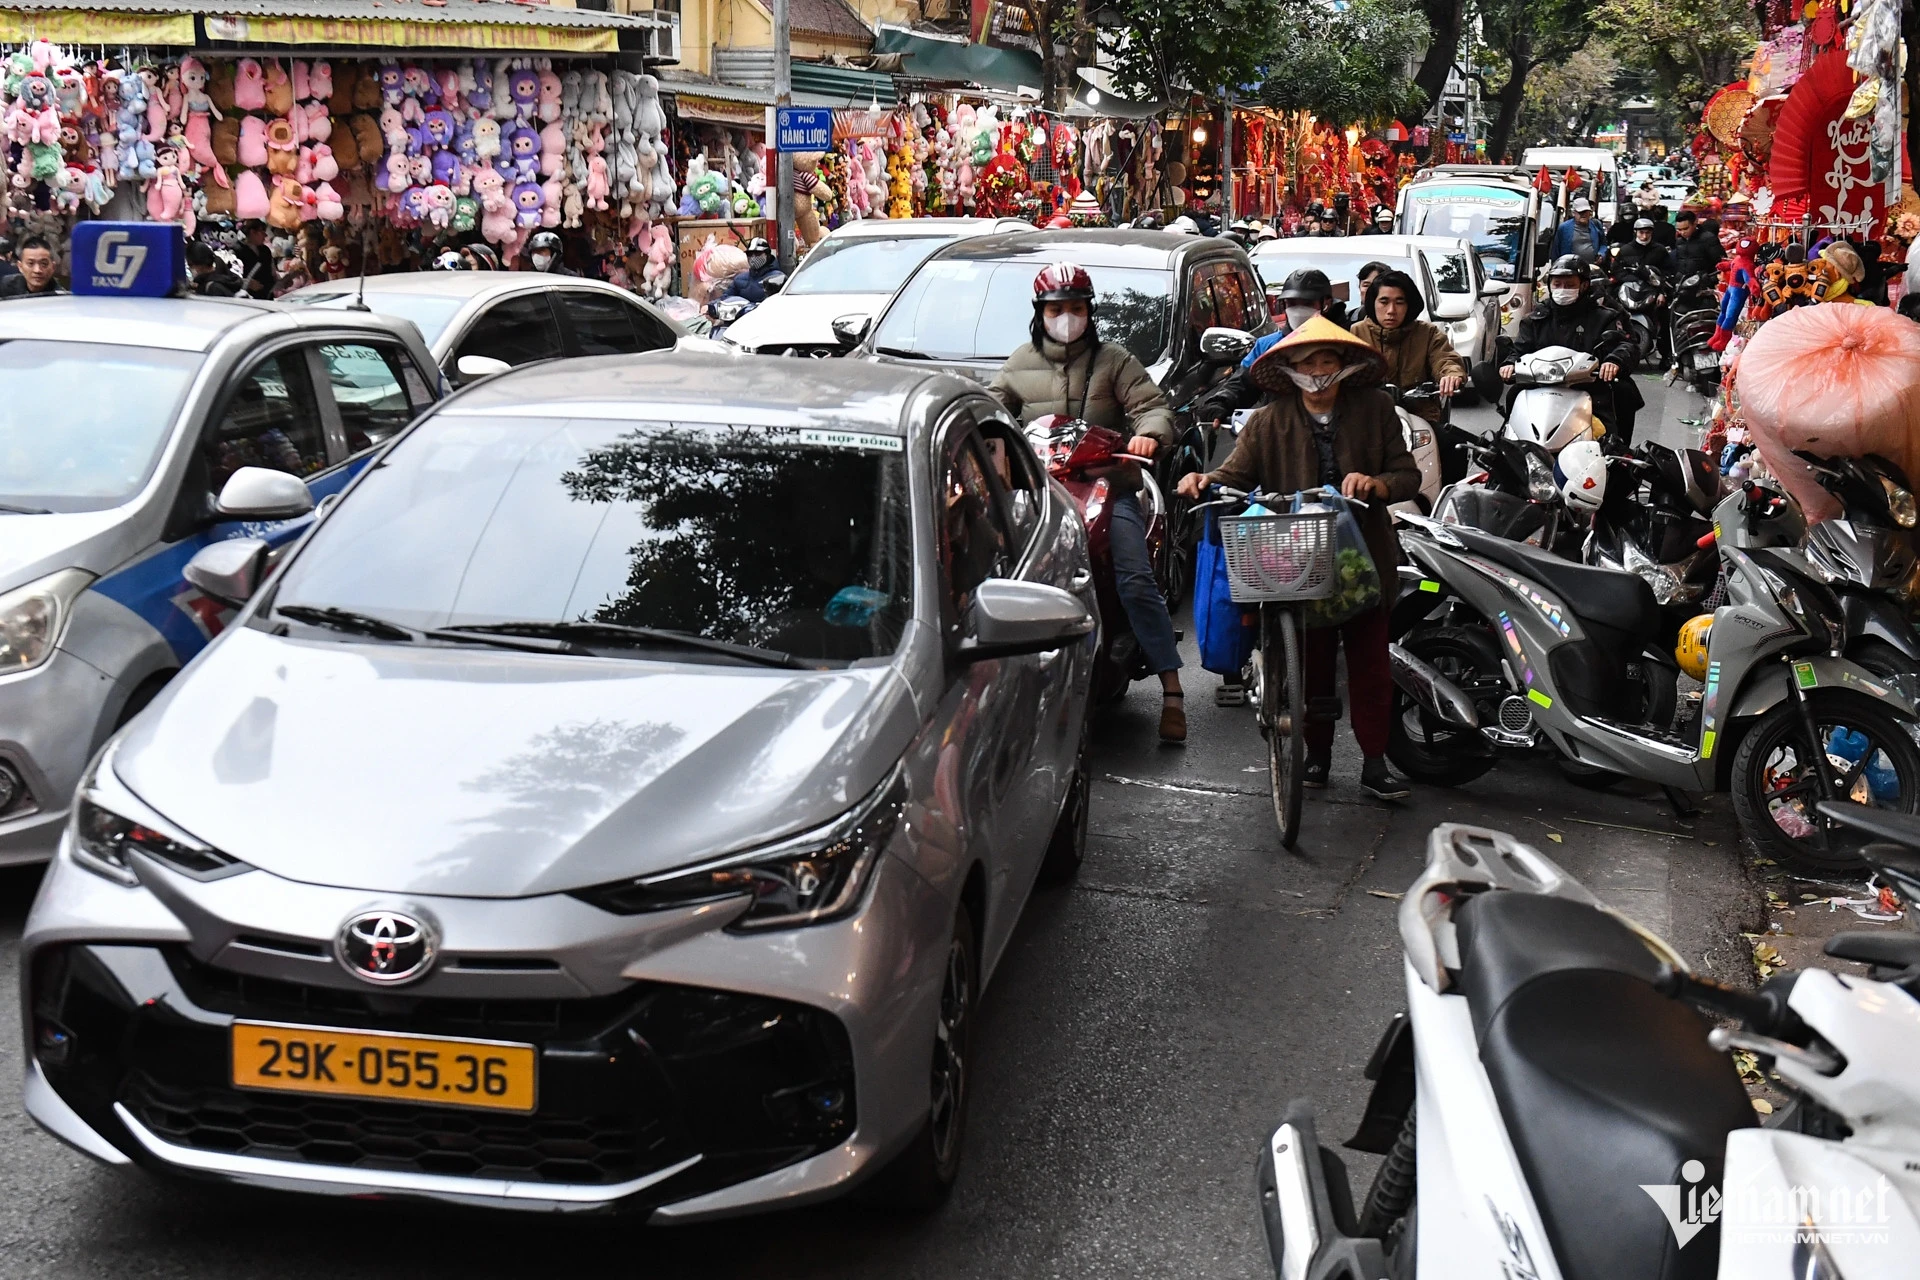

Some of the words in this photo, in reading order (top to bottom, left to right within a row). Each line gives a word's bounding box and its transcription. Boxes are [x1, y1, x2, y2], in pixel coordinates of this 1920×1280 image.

[797, 111, 816, 124] PHỐ
[781, 127, 805, 145] HÀNG
[806, 128, 828, 147] LƯỢC
[94, 230, 149, 289] G7
[806, 433, 821, 441] XE
[257, 1038, 508, 1096] 29K-055.36
